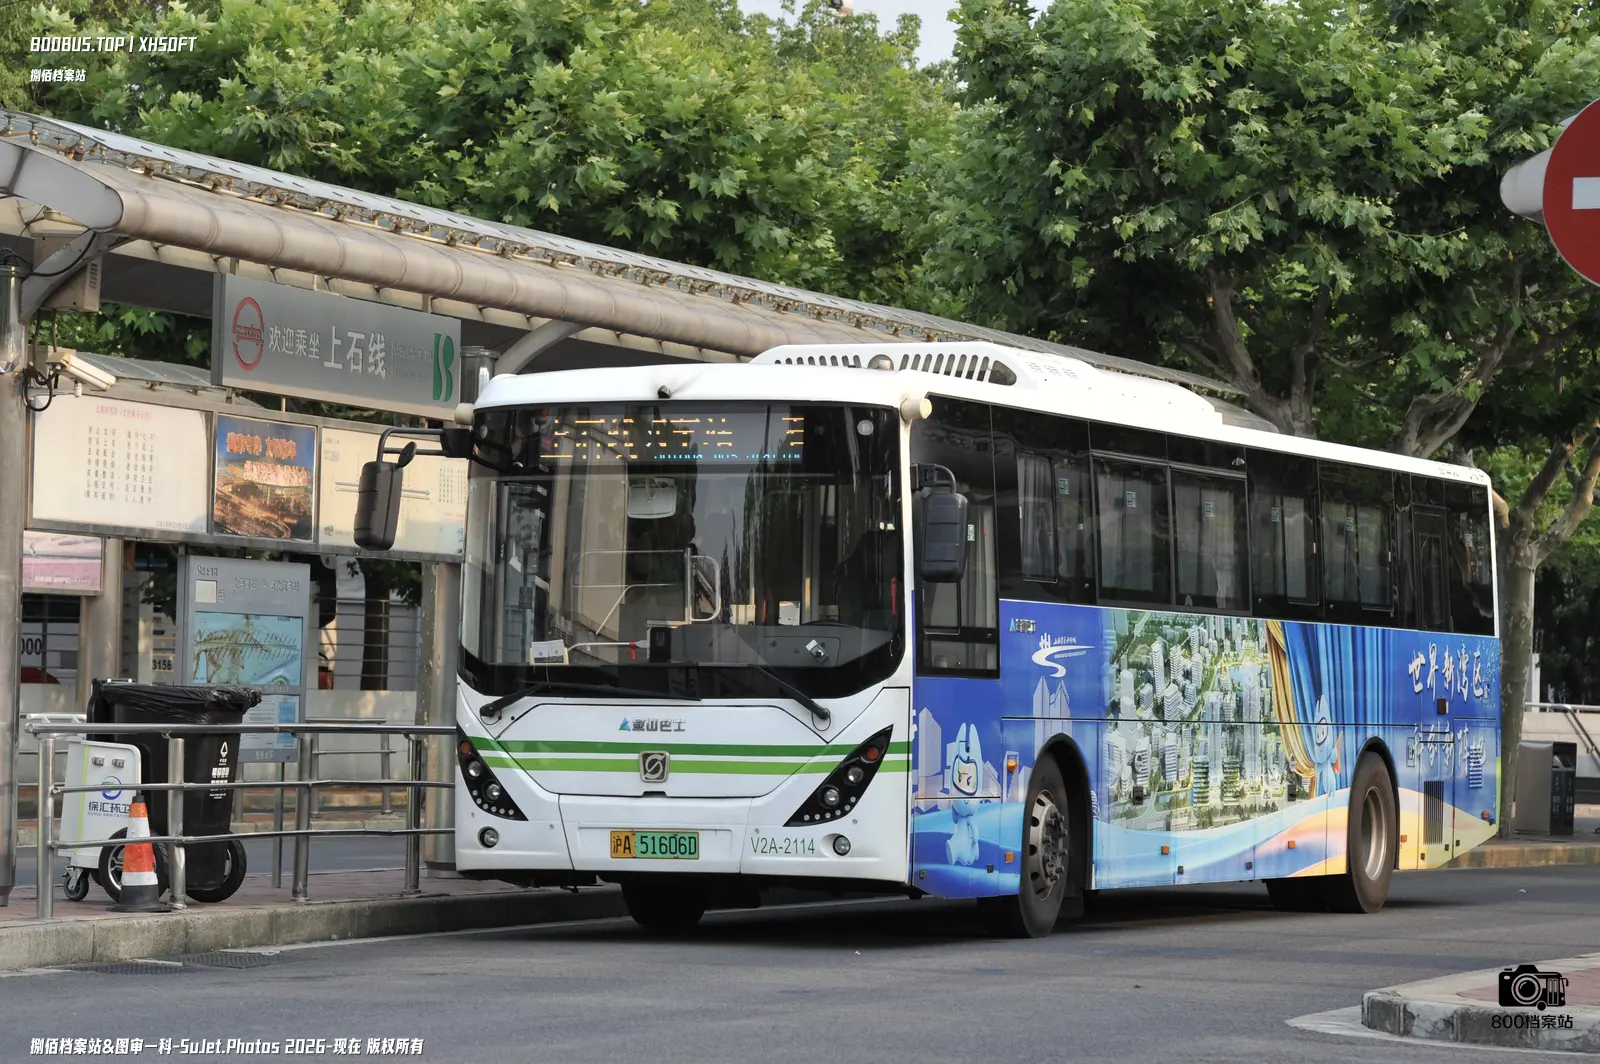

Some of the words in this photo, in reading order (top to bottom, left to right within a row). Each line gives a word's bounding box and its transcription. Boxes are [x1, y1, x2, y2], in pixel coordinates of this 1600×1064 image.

[268, 325, 321, 360] 欢迎乘坐
[323, 325, 387, 380] 上石线
[152, 659, 172, 671] 3156
[1408, 641, 1484, 702] 世界新湾区
[632, 718, 686, 732] 金山巴士
[88, 801, 131, 814] 徐汇环卫
[612, 835, 632, 854] 沪A
[639, 835, 697, 855] 51606D
[750, 837, 815, 854] V2A-2114
